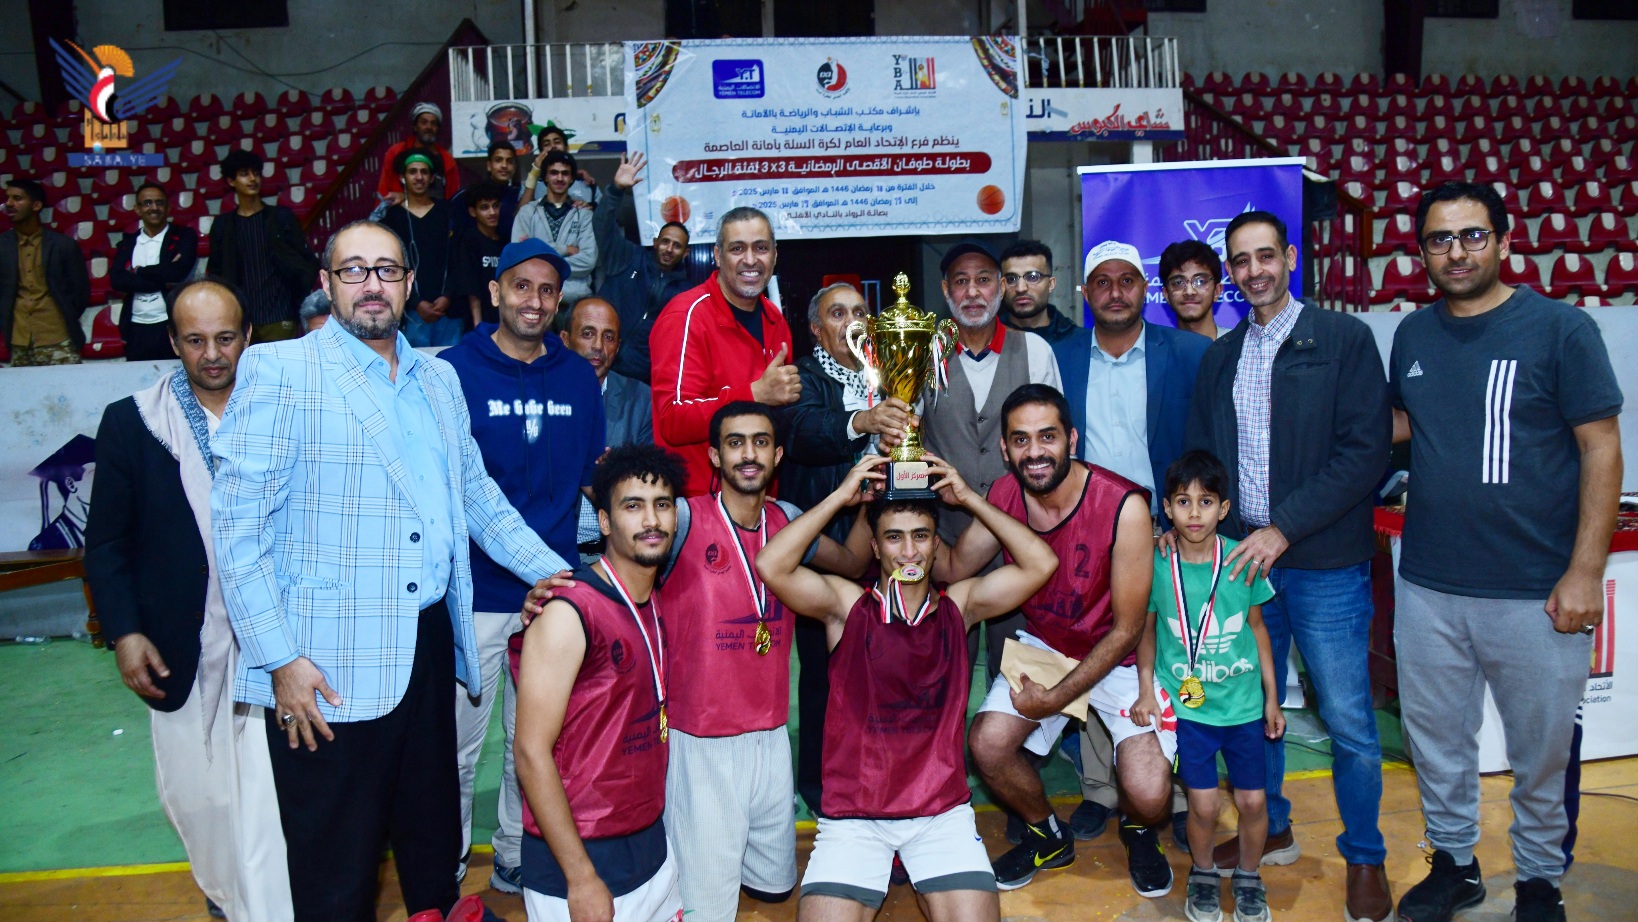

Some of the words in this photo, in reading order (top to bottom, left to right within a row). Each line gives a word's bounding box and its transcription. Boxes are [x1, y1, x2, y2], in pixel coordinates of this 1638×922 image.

[780, 108, 818, 119] والرياضة
[820, 107, 853, 117] الشباب
[855, 107, 883, 117] مكتب
[886, 106, 920, 117] بإشراف
[771, 125, 807, 135] اليمنية
[858, 123, 893, 133] وبرعاية
[704, 140, 748, 152] العاصمة
[752, 139, 781, 152] بأمانة
[784, 139, 815, 150] السلة
[818, 138, 840, 151] لكرة
[844, 137, 871, 151] العام
[911, 136, 929, 149] فرع
[932, 136, 960, 149] ينظم
[734, 161, 759, 174] لفئة
[788, 159, 844, 175] الرمضانية
[846, 158, 892, 171] الأقصى
[894, 157, 932, 172] طوفان
[935, 156, 971, 171] بطولة
[694, 162, 732, 179] الرجال
[739, 188, 758, 196] 2025
[759, 187, 779, 197] مارس
[792, 186, 819, 196] الموافق
[831, 185, 849, 193] 1446
[850, 184, 873, 194] رمضان
[885, 185, 895, 193] من
[897, 183, 918, 193] الفترة
[919, 182, 936, 192] خلال
[758, 201, 777, 209] 2025
[780, 201, 798, 210] مارس
[812, 200, 839, 209] الموافق
[850, 198, 869, 206] 1446
[870, 198, 892, 207] رمضان
[904, 197, 918, 206] إلى
[814, 211, 843, 220] بالنادي
[845, 209, 865, 219] الرواد
[866, 209, 888, 218] بصالة
[1074, 544, 1090, 578] 2
[716, 629, 745, 640] اليمنية
[716, 642, 745, 651] YEMEN
[623, 742, 653, 756] YEMEN
